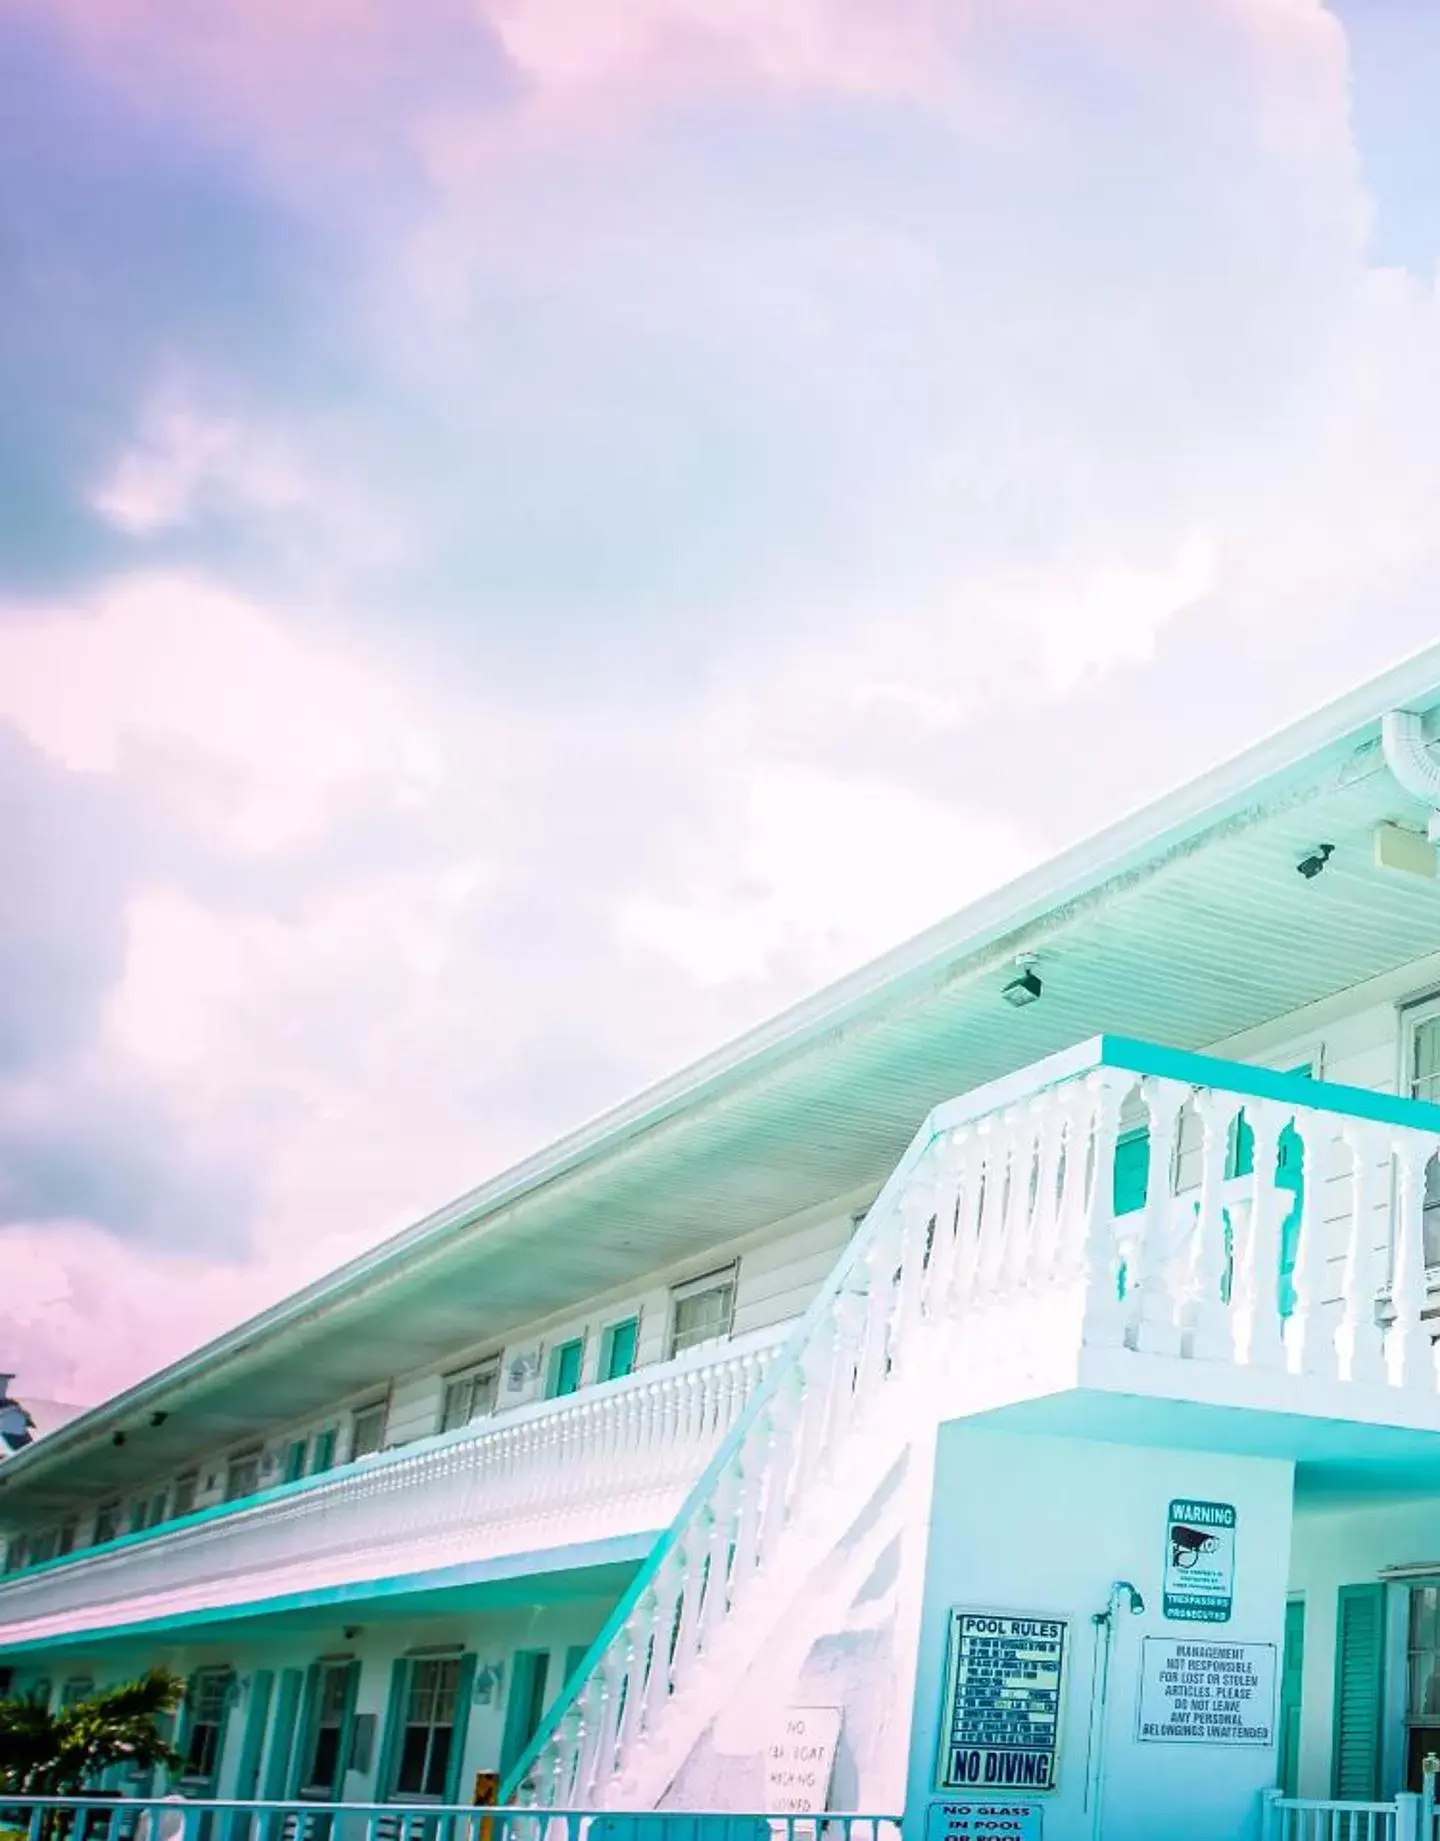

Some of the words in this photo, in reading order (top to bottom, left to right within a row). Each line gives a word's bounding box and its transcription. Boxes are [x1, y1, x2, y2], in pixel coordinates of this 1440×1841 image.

[1172, 1504, 1233, 1525] WARNING
[966, 1620, 1006, 1635] POOL
[1011, 1622, 1059, 1638] RULES
[1176, 1646, 1244, 1660] MANAGEMENT
[1167, 1658, 1185, 1670] NOT
[1188, 1660, 1253, 1674] RESPONSIBLE
[1160, 1671, 1178, 1682] FOR
[1181, 1672, 1204, 1684] LOST
[1207, 1674, 1220, 1685] OR
[1222, 1675, 1258, 1686] STOLEN
[1216, 1687, 1252, 1699] PLEASE
[1174, 1699, 1188, 1710] DO
[1190, 1700, 1210, 1711] NOT
[1212, 1700, 1241, 1712] LEAVE
[1170, 1712, 1191, 1723] ANY
[1194, 1712, 1243, 1726] PERSONAL
[1143, 1723, 1205, 1737] BELONGINGS
[1207, 1725, 1268, 1738] UNATTENDED
[954, 1750, 980, 1782] NO
[984, 1751, 1049, 1784] DIVING
[943, 1806, 971, 1815] NO
[977, 1807, 1031, 1817] GLASS
[949, 1821, 969, 1829] IN
[974, 1821, 1022, 1831] POOL
